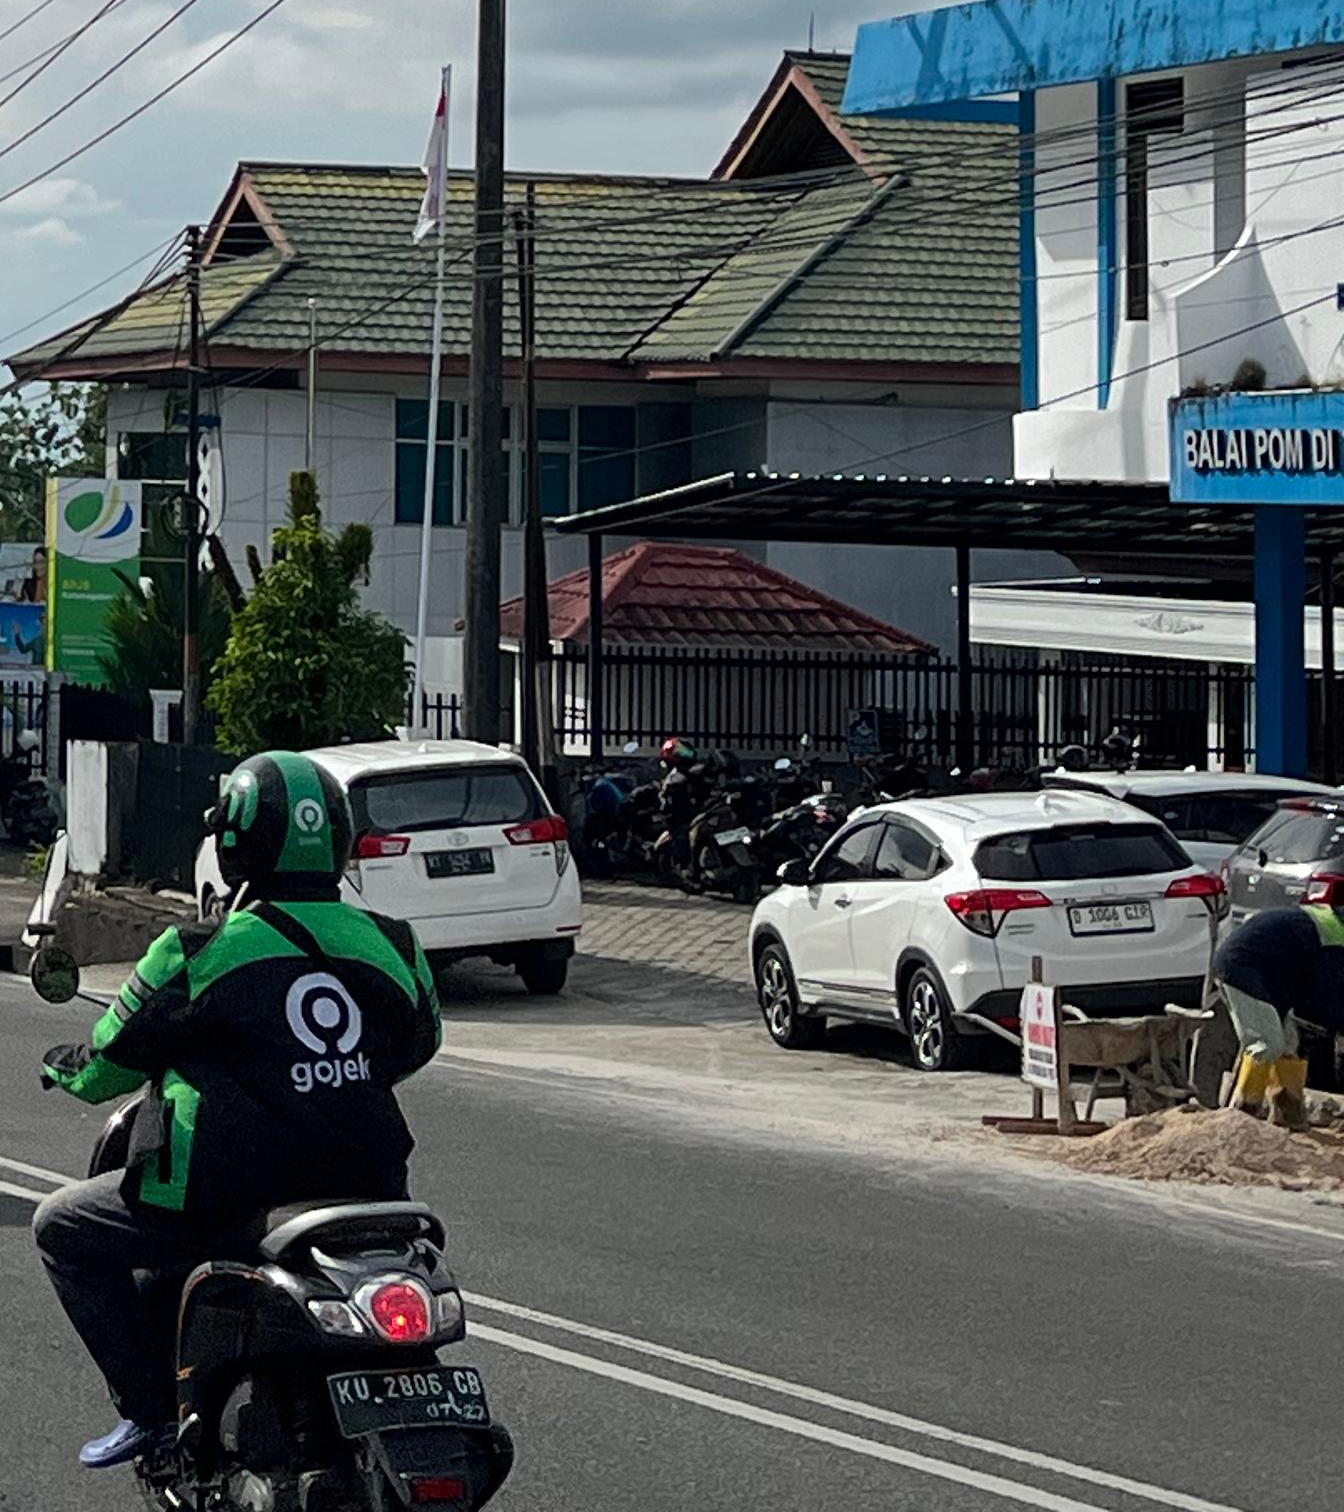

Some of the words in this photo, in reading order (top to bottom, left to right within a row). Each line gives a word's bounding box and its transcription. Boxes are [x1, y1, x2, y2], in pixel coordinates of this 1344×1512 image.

[1183, 428, 1248, 470] BALAI
[1254, 428, 1304, 471] POM
[1311, 428, 1334, 471] DI
[291, 1051, 371, 1092] gojek
[336, 1376, 370, 1405] KU
[383, 1372, 444, 1399] 2806
[453, 1370, 482, 1395] CB
